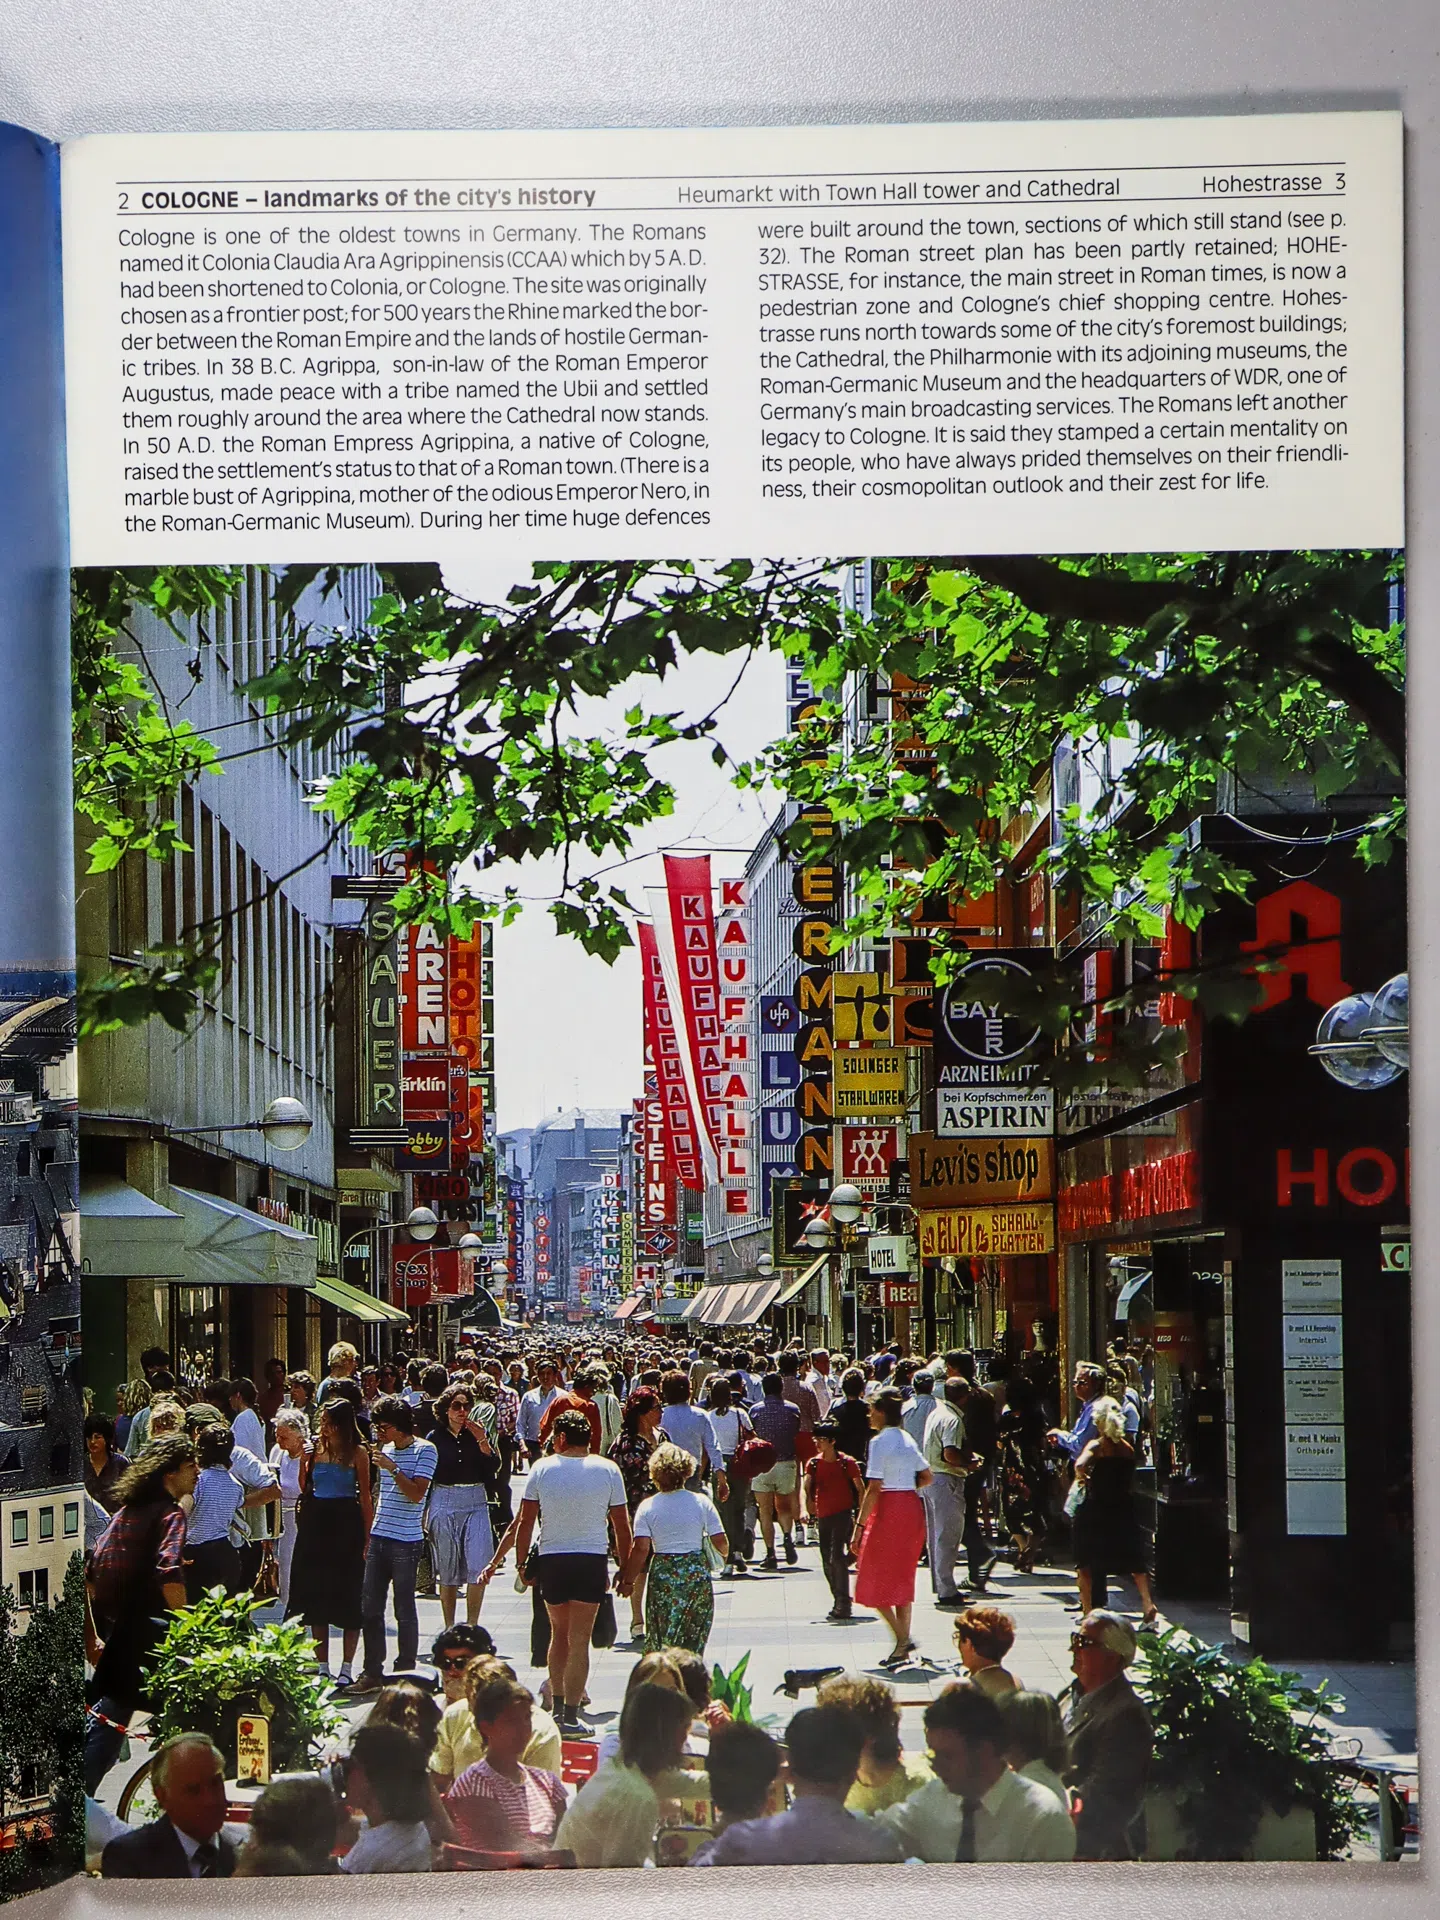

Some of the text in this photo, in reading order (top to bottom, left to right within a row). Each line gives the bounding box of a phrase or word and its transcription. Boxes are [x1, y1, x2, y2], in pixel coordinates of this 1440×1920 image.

[678, 177, 1120, 204] Heumarkt with Town Hall tower and Cathedral
[1203, 172, 1346, 193] Hohestrasse 3
[118, 192, 129, 210] 2
[141, 190, 239, 209] COLOGNE
[264, 188, 379, 208] landmarks
[385, 188, 409, 207] of
[413, 187, 451, 206] the
[456, 187, 512, 208] city's
[517, 186, 596, 207] history
[118, 223, 707, 248] Cologne is one of the oldest towns in Germany. The Romans
[759, 235, 1348, 265] 32). The Roman street plan has been partly retained; HOHE-
[122, 352, 709, 377] ic tribes. In 38 B.C. Agrippa, son-in-law of the Roman Emperor
[759, 340, 1348, 371] the Cathedral, the Philharmonie with its adjoining museums, the
[122, 404, 709, 431] them roughly around the area where the Cathedral now stands.
[123, 430, 709, 455] In 50 A.D. the Roman Empress Agrippina, a native of Cologne,
[762, 470, 1269, 499] ness, their cosmopolitan outlook and their zest for life.
[124, 507, 711, 532] the Roman-Germanic Museum). During her time huge defences
[416, 922, 446, 1045] AREN
[370, 909, 397, 1114] SAUER
[950, 1001, 1019, 1019] BAY
[722, 880, 750, 1214] KAUFHALLE
[843, 1057, 899, 1074] SOLINGER
[939, 1064, 1050, 1083] ARZNEIMITT
[400, 1076, 446, 1092] ärklin
[838, 1089, 905, 1106] STAHLWAREN
[943, 1091, 1047, 1106] bei Kopfschmerzen
[941, 1105, 1047, 1129] ASPIRIN
[408, 1132, 443, 1154] obby
[646, 1102, 665, 1222] STEINS
[919, 1140, 1039, 1193] Levi's shop
[1277, 1147, 1410, 1208] HO
[937, 1215, 974, 1255] ELPI
[991, 1212, 1045, 1233] SCHALL-
[991, 1232, 1045, 1253] PLATTEN
[395, 1260, 428, 1275] Sex
[871, 1249, 896, 1269] HOTEL
[1296, 1446, 1334, 1455] Orthopäde
